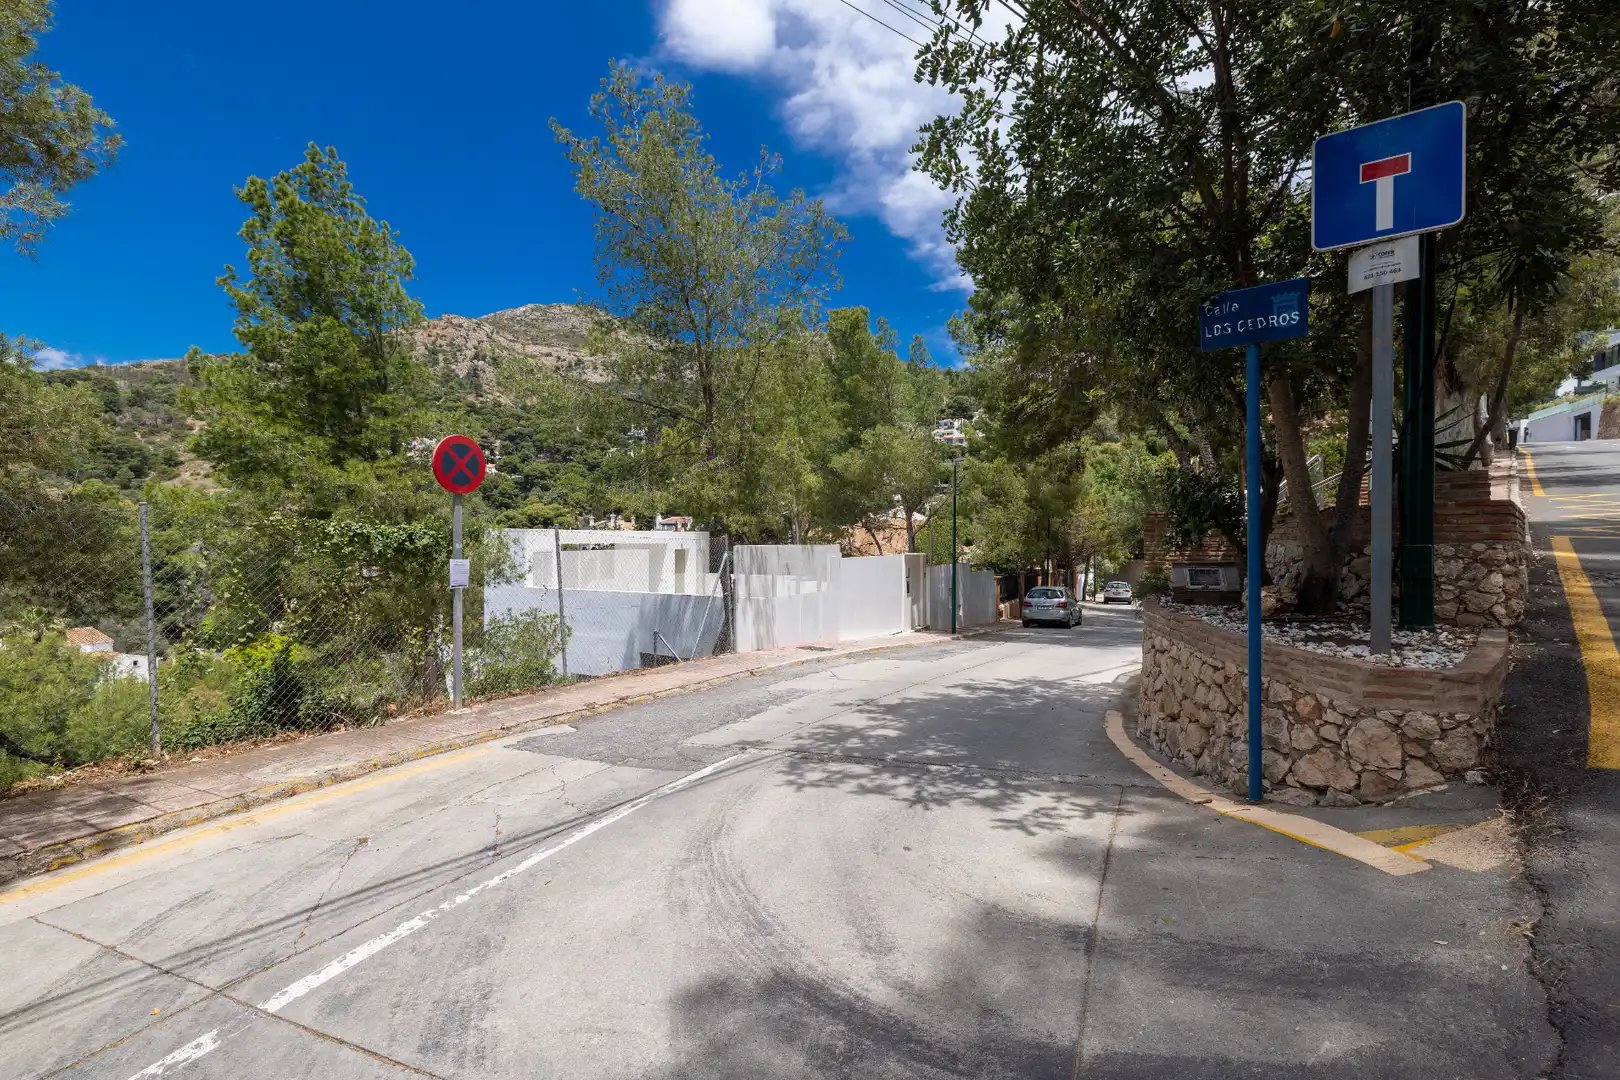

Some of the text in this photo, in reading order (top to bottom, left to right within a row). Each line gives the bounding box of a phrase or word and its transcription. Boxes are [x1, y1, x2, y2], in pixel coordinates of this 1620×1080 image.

[1204, 302, 1239, 317] Calle
[1204, 311, 1300, 338] LOS CEDROS
